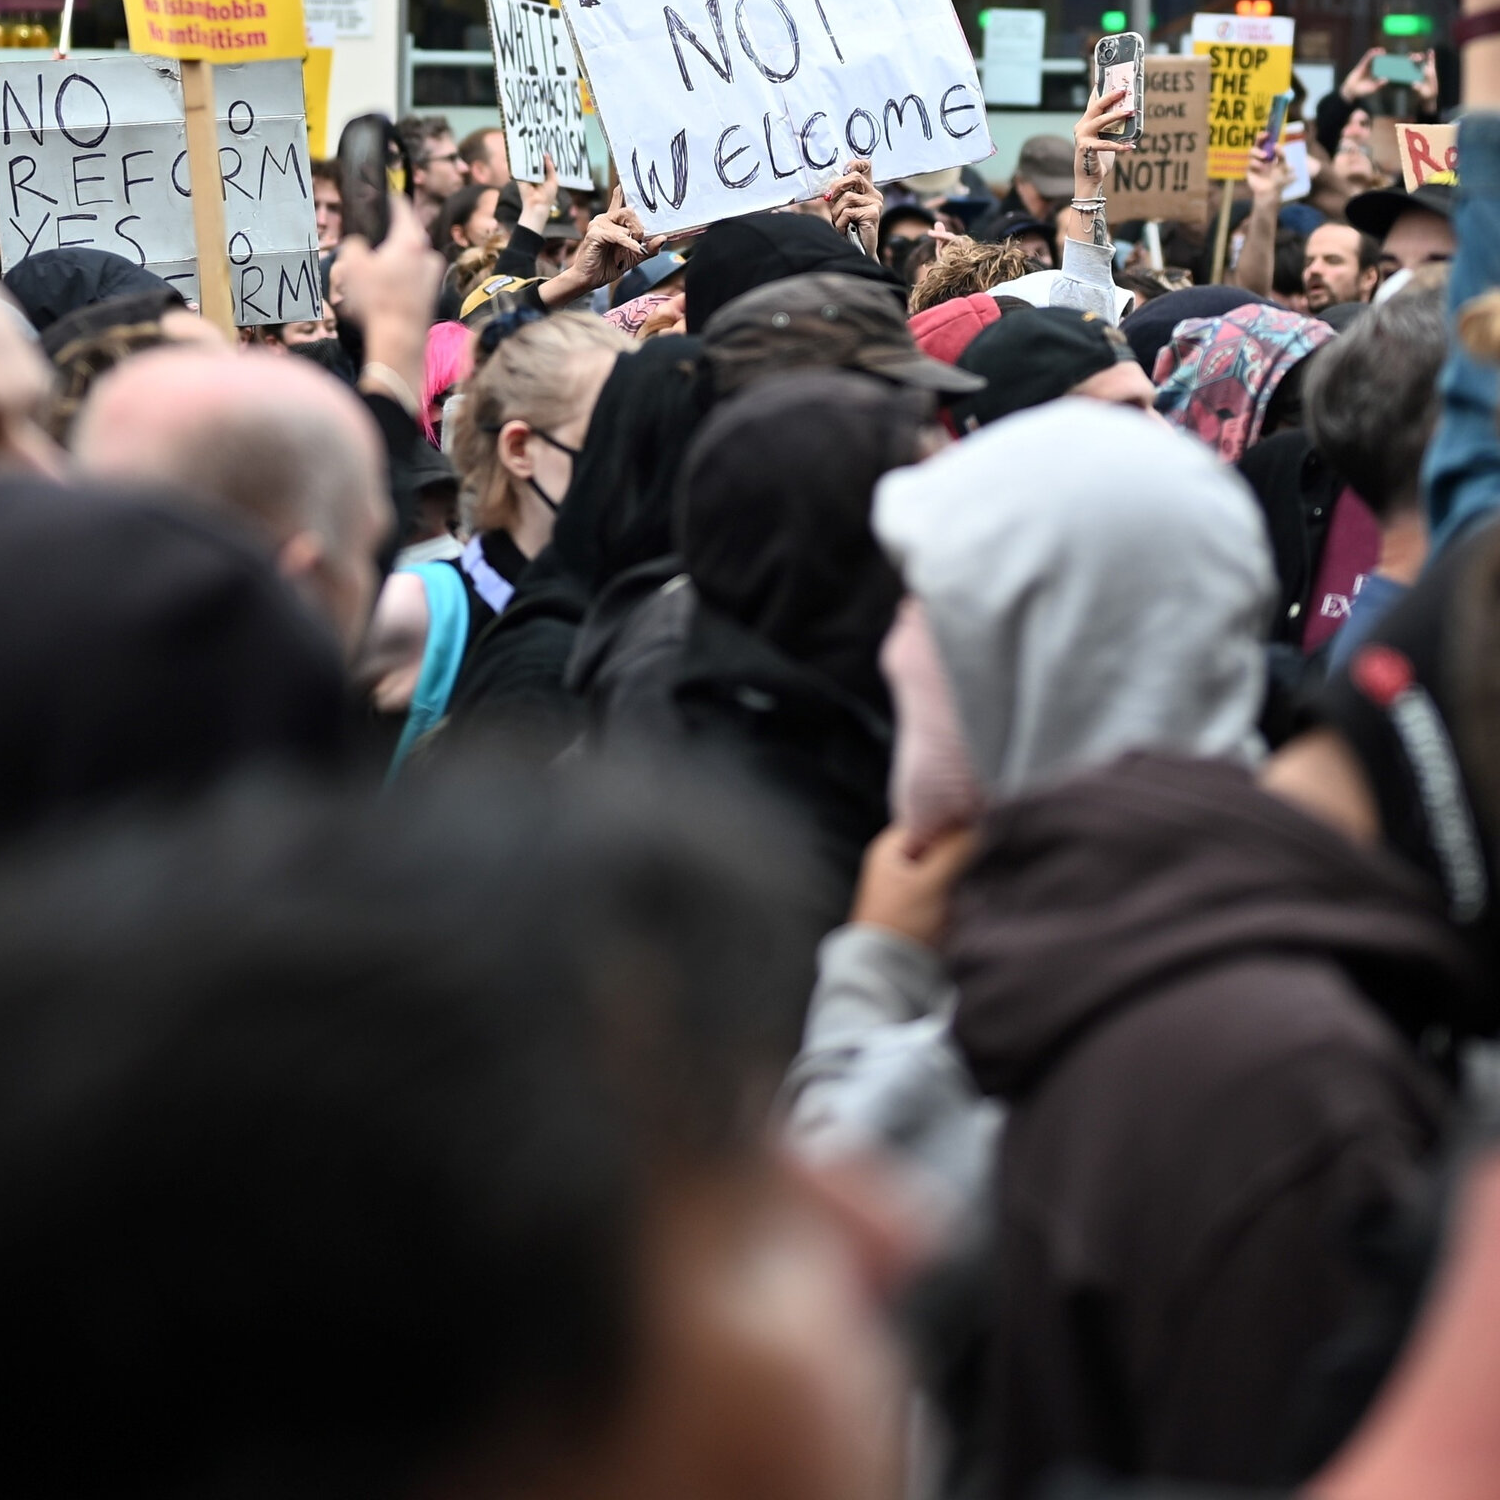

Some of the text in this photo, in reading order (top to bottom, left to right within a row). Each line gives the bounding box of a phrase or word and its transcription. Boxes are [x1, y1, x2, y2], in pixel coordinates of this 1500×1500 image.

[1209, 45, 1269, 70] STOP
[504, 76, 583, 128] SUPREMACY IS
[1210, 72, 1251, 96] THE
[2, 73, 111, 149] NO
[518, 124, 594, 181] TERRORISM
[1113, 160, 1190, 194] NOT!!
[8, 211, 147, 269] YES
